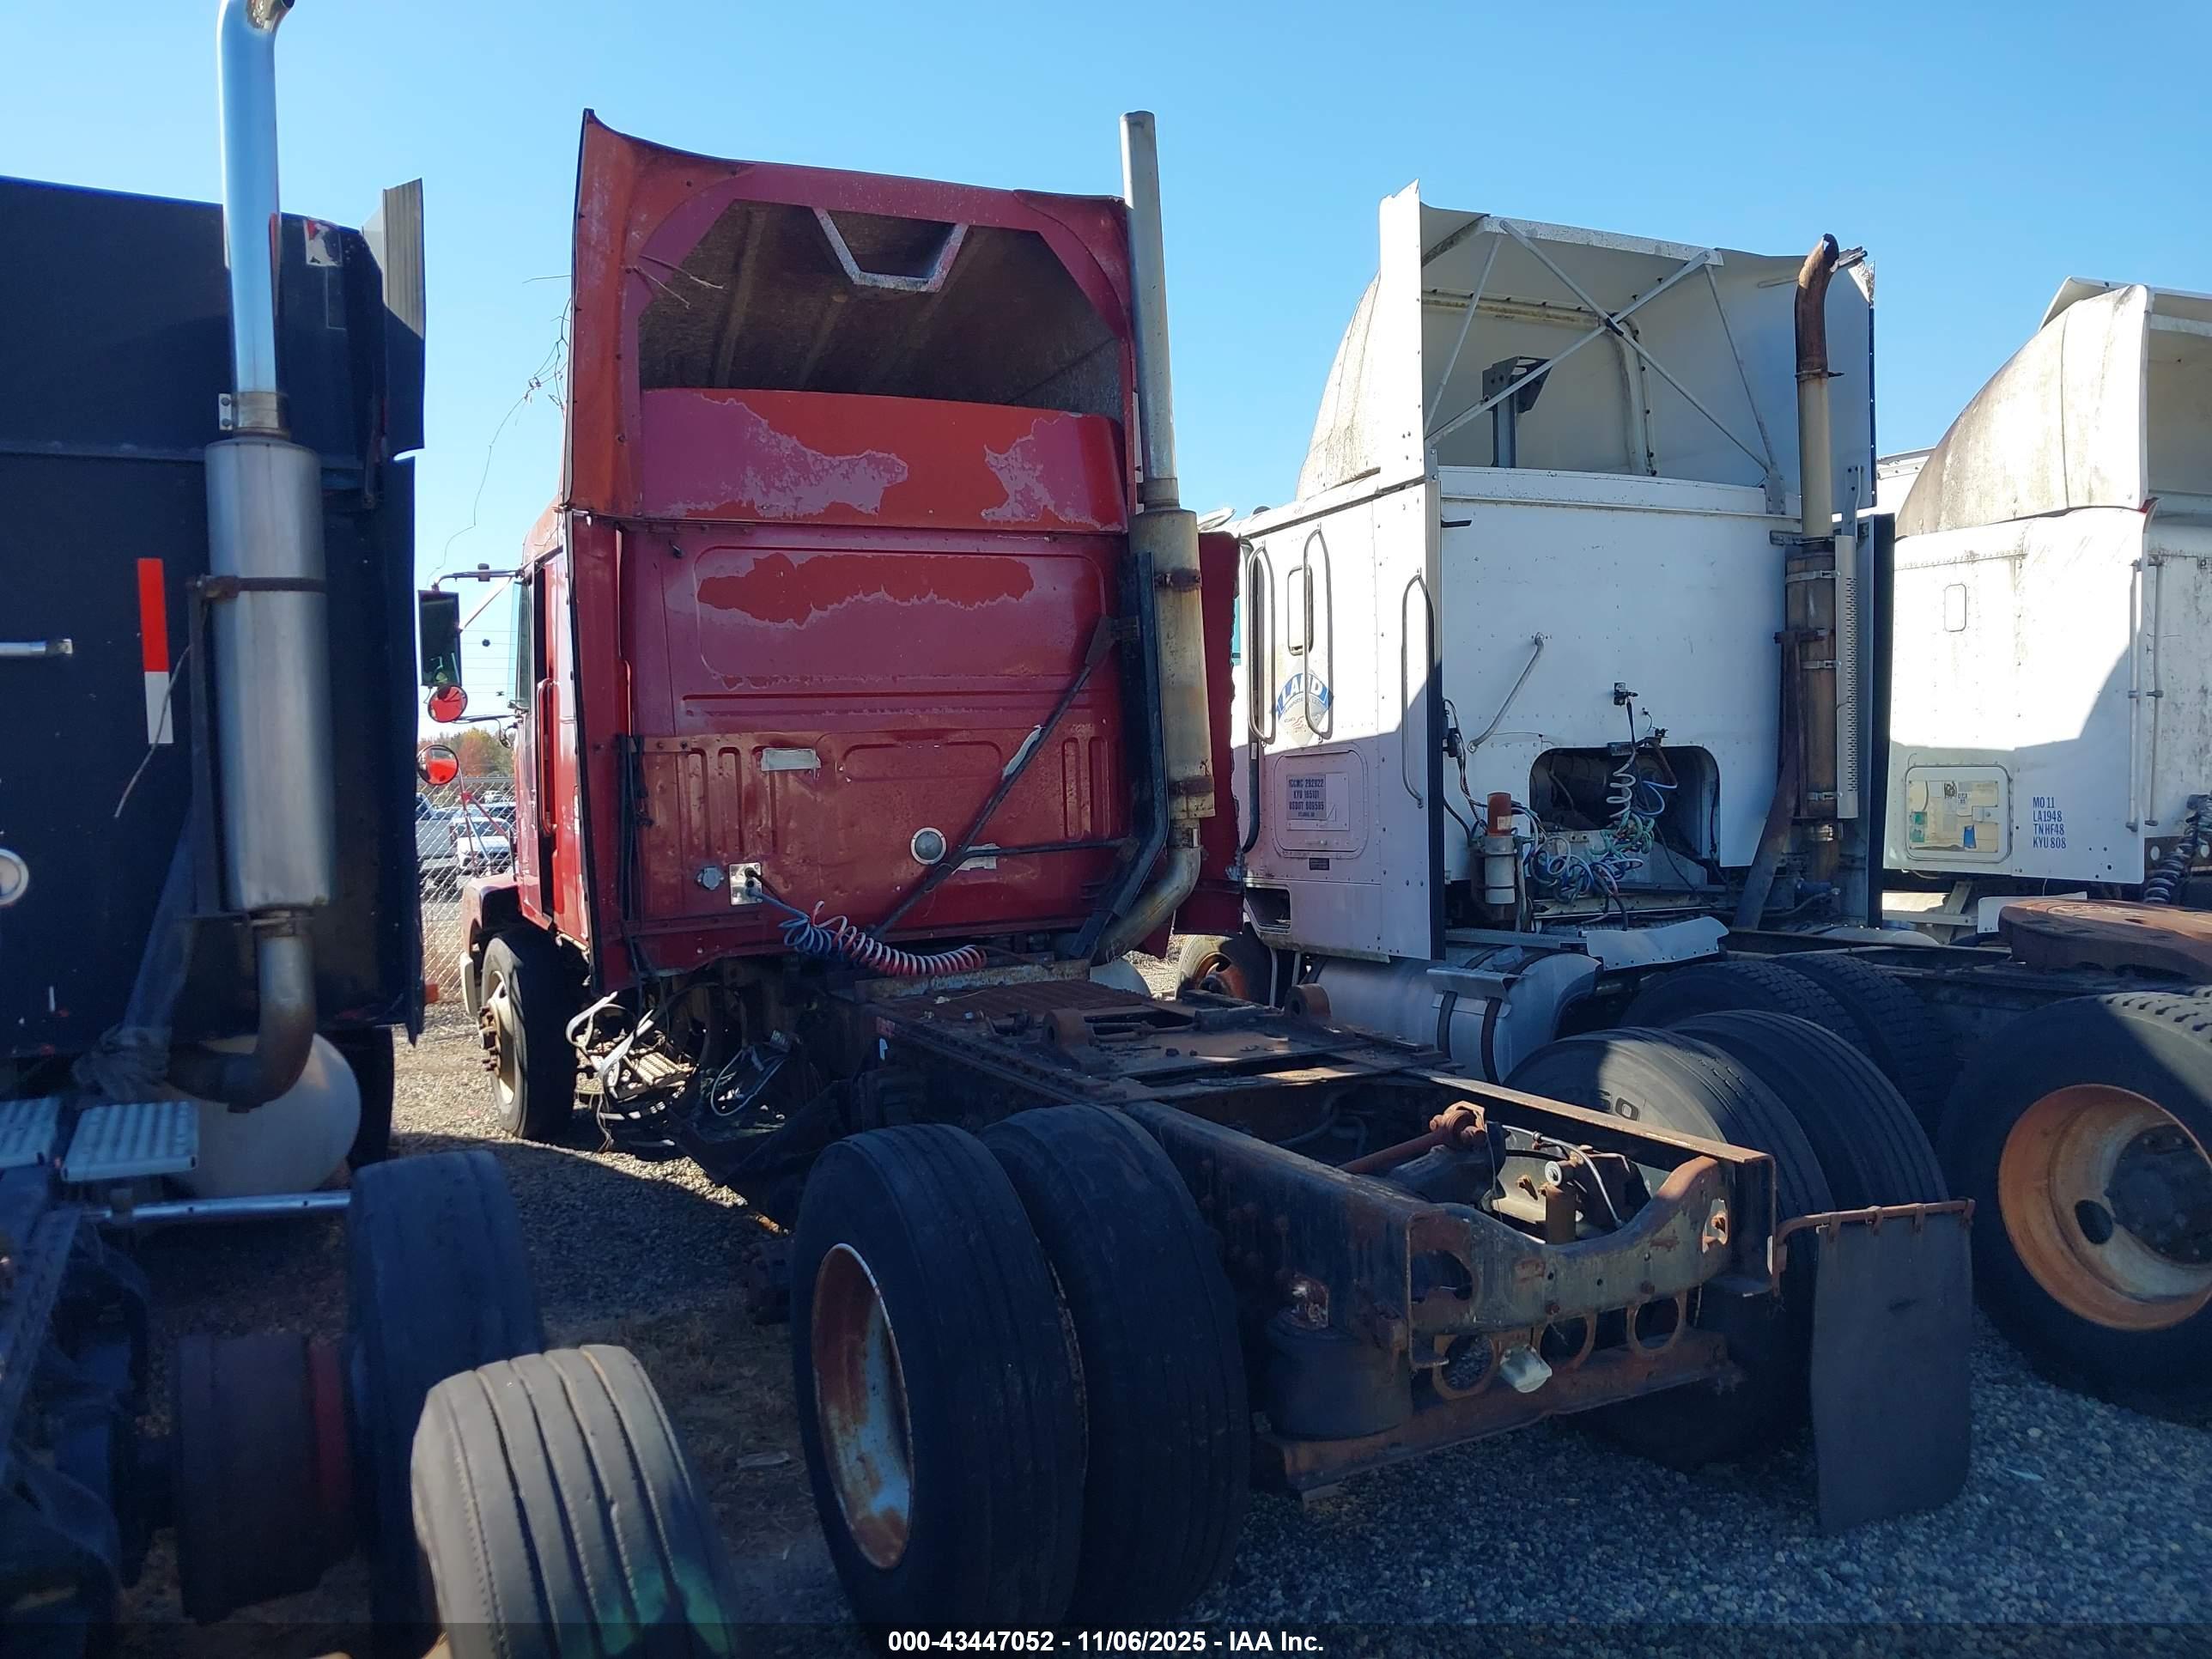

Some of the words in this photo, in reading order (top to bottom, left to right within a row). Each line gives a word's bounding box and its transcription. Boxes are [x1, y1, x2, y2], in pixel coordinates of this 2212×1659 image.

[2033, 797, 2045, 809] MO
[2047, 797, 2055, 809] 11
[2033, 836, 2049, 849] KYU
[2050, 836, 2067, 849] 808
